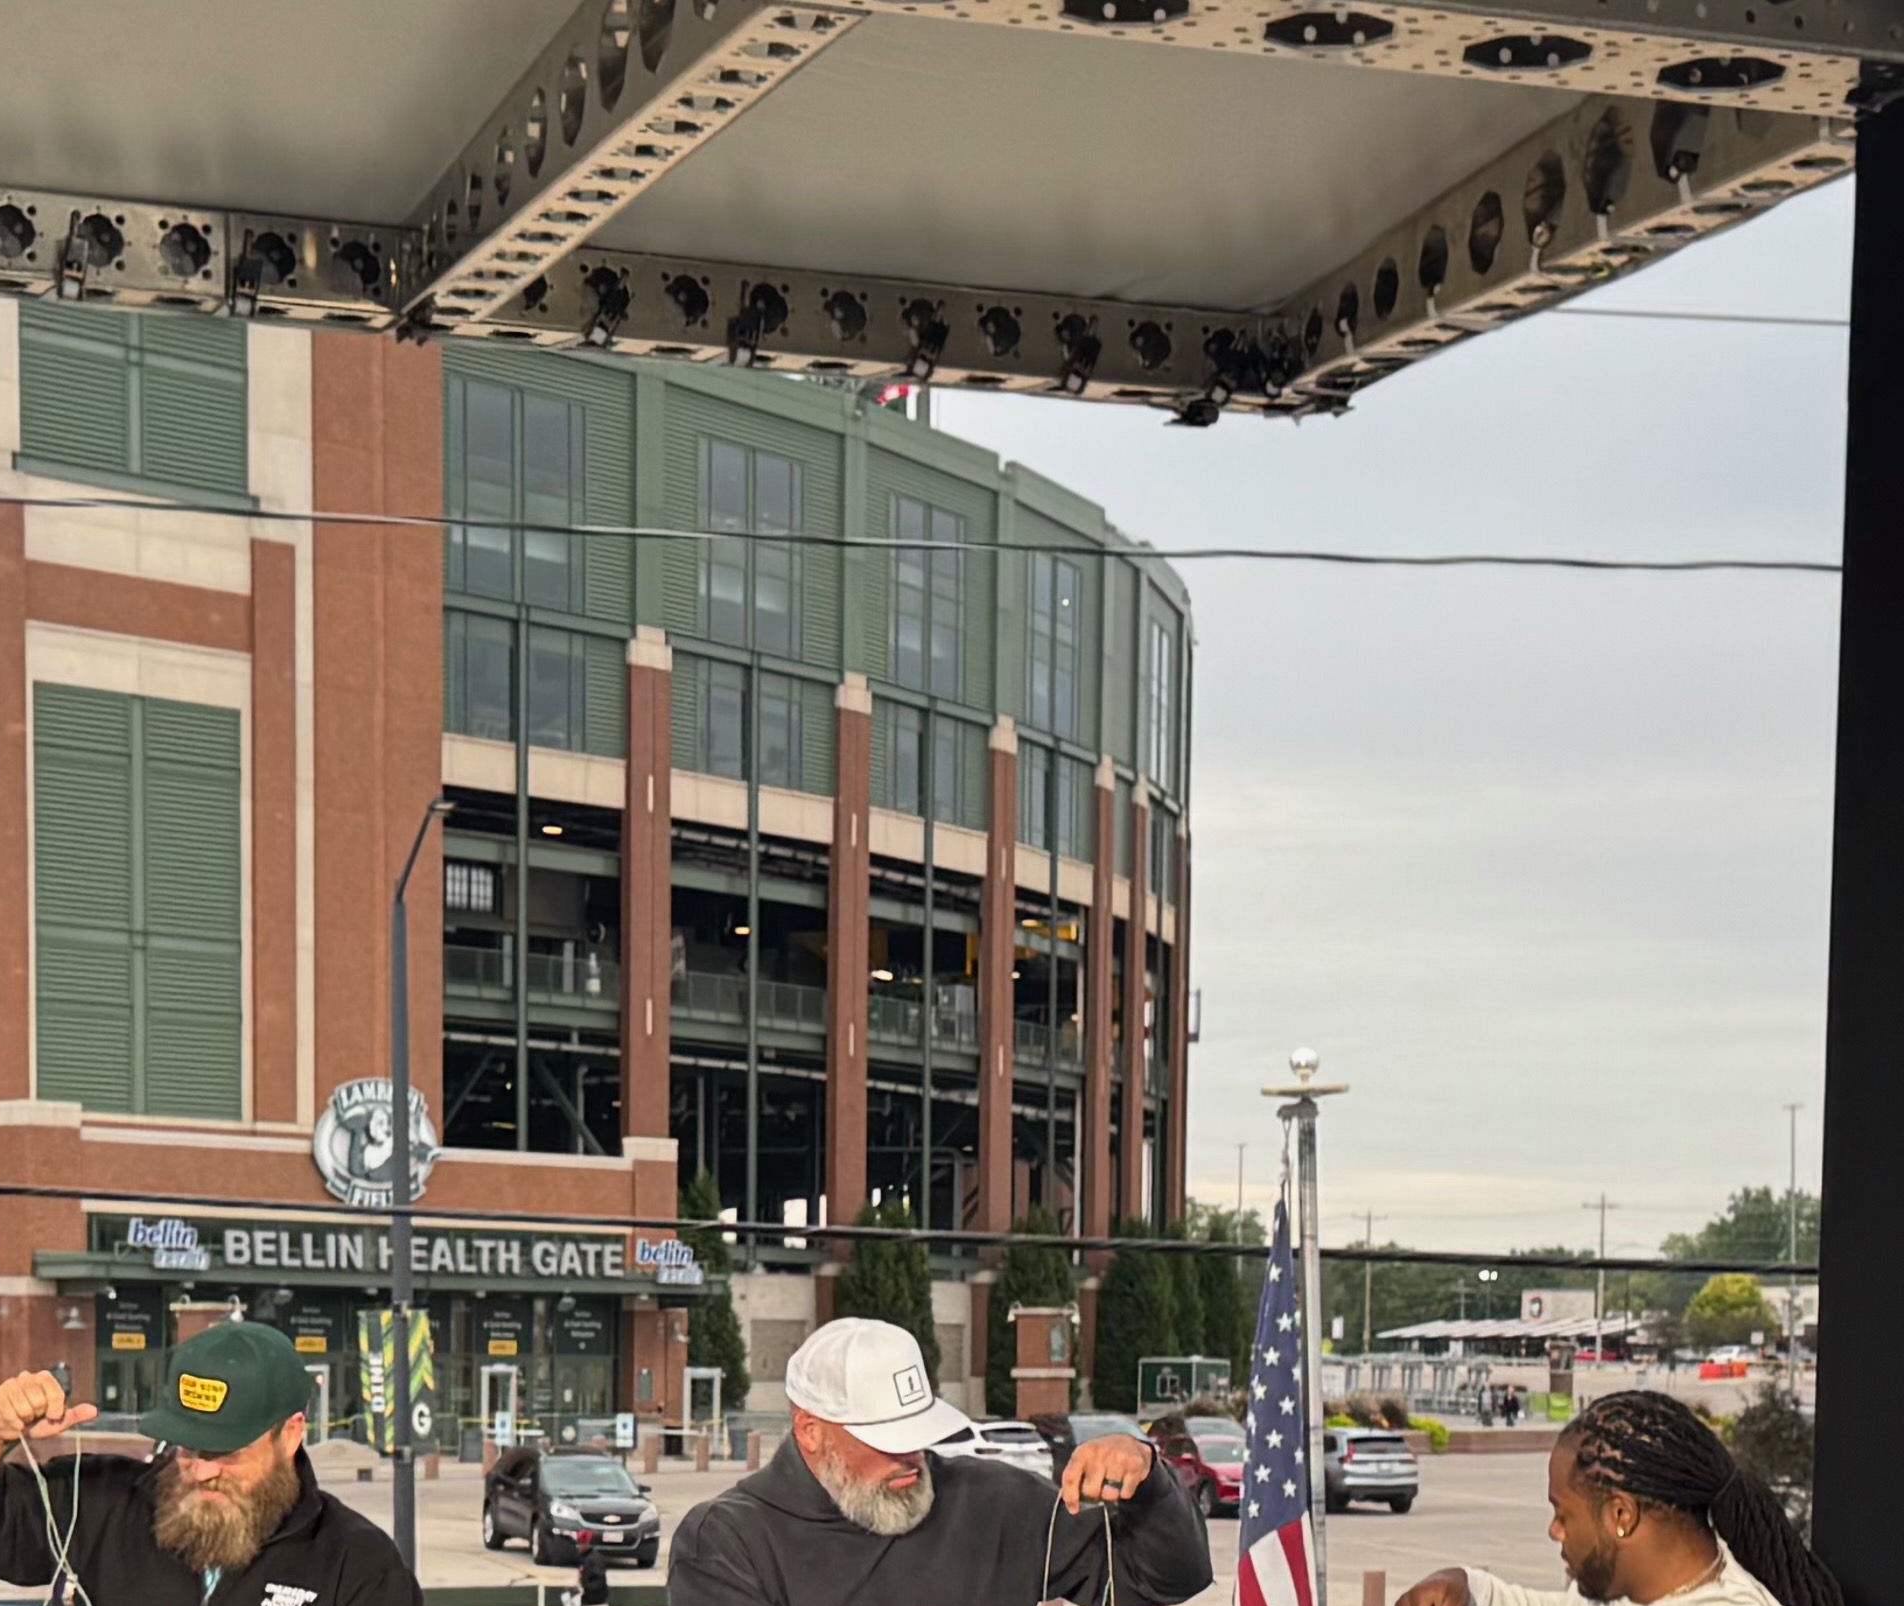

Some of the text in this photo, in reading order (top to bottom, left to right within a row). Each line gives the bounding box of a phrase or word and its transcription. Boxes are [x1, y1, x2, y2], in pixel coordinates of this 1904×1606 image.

[128, 1217, 198, 1249] bellin
[224, 1229, 364, 1270] BELLIN
[532, 1240, 625, 1278] GATE
[636, 1238, 694, 1266] bellin
